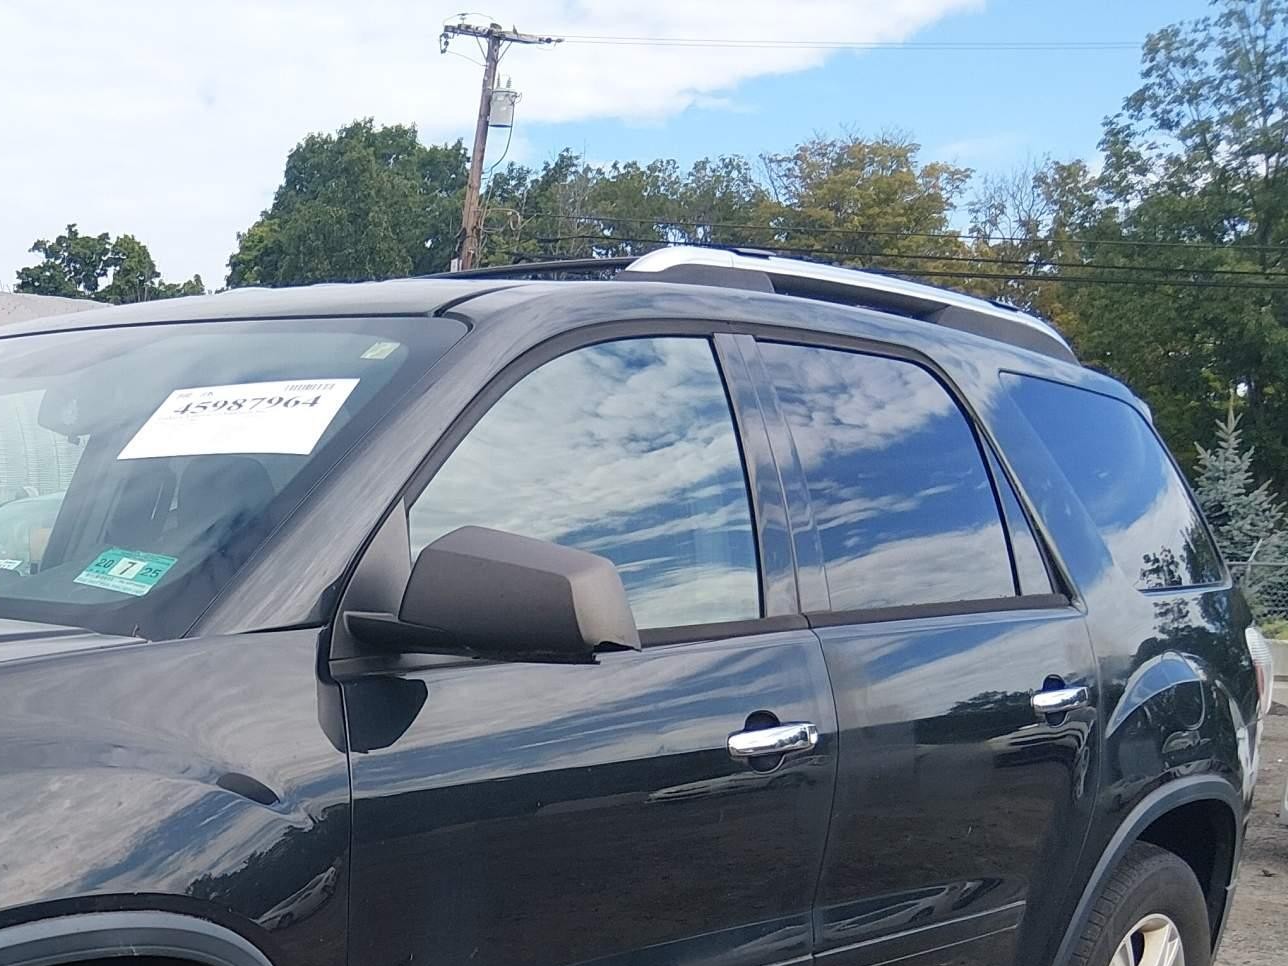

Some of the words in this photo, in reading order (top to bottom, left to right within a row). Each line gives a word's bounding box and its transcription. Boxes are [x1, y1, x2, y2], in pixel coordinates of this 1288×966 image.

[173, 394, 322, 415] 45987964
[95, 558, 115, 569] 20
[119, 561, 137, 576] 7
[140, 567, 162, 578] 25
